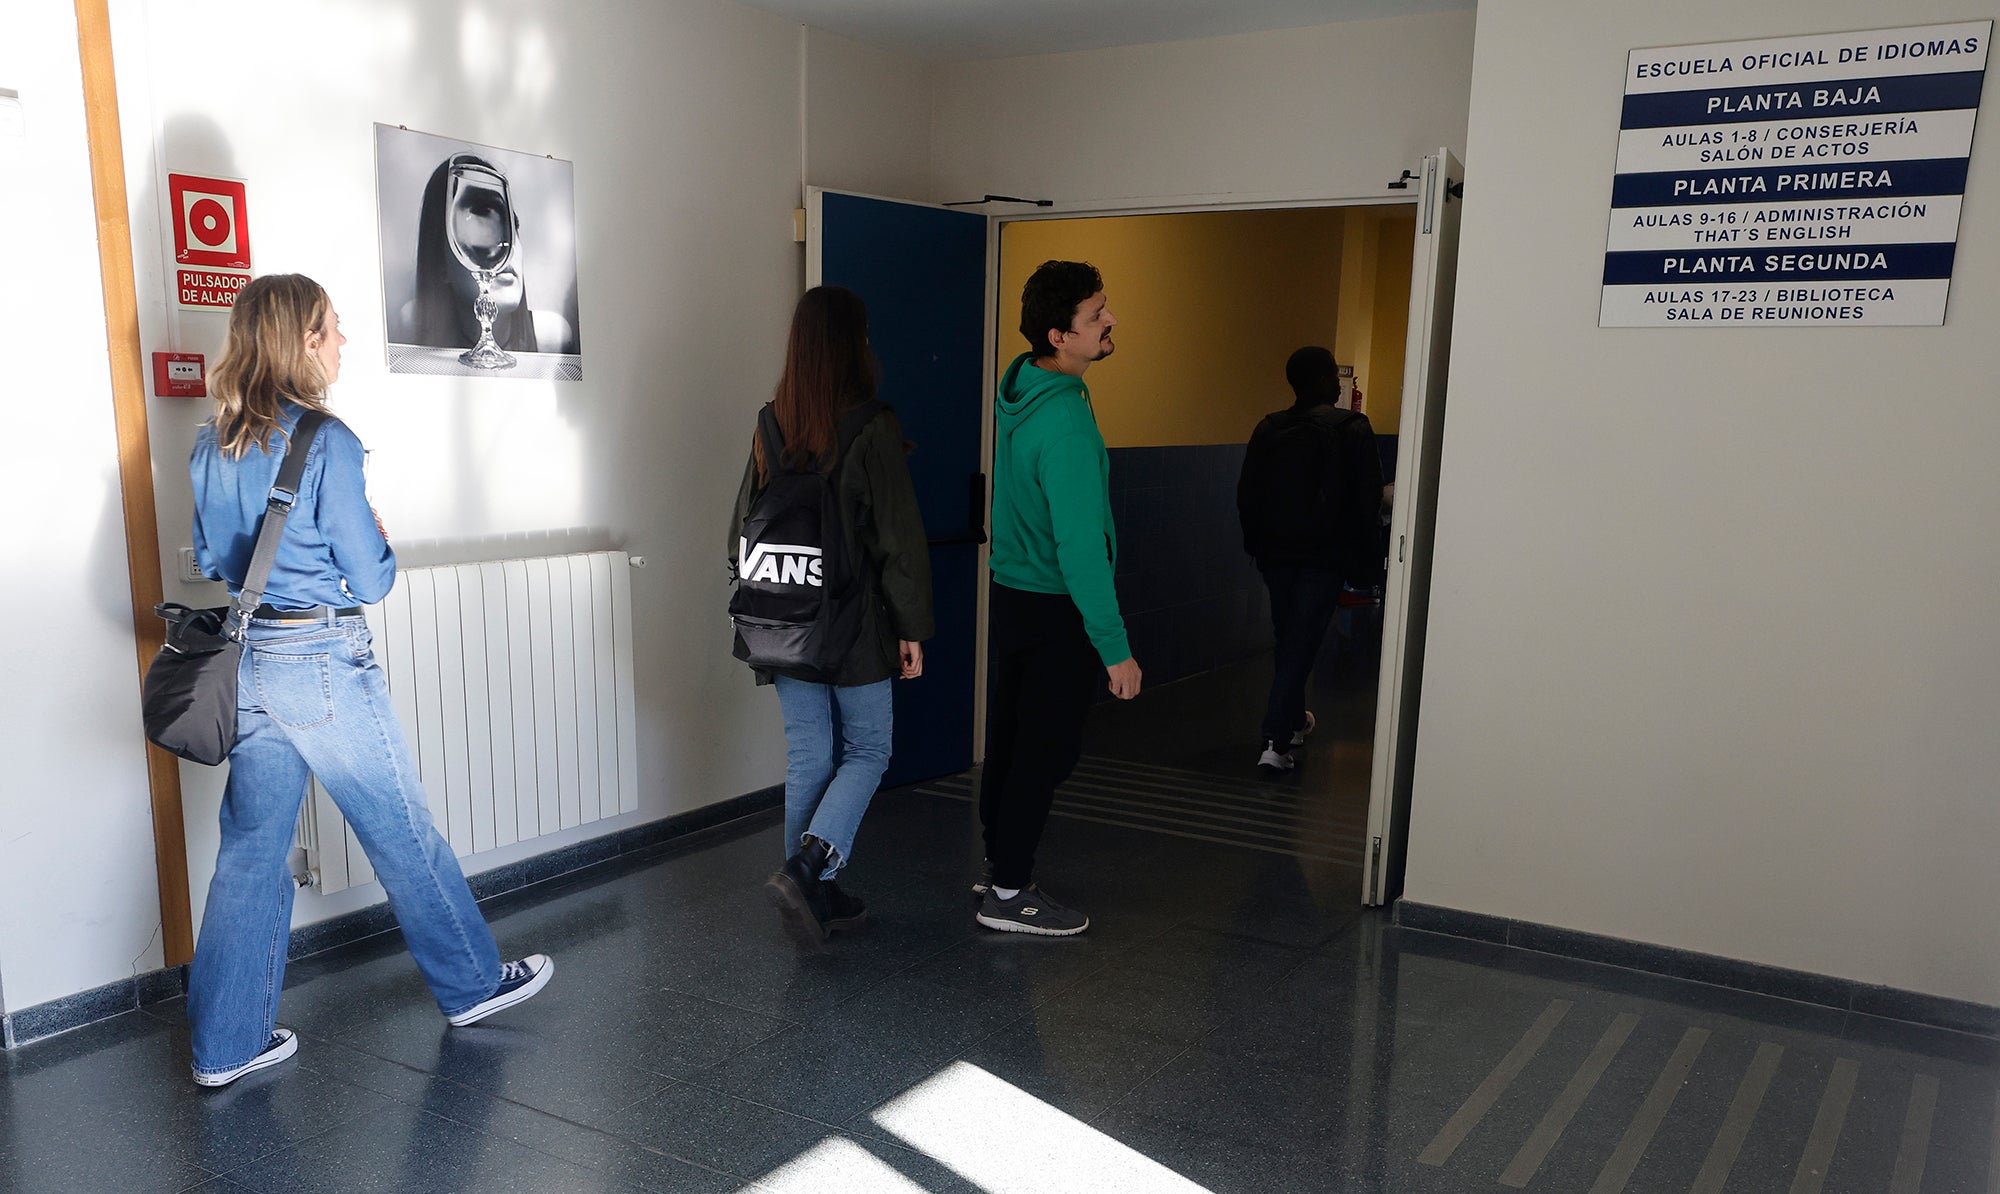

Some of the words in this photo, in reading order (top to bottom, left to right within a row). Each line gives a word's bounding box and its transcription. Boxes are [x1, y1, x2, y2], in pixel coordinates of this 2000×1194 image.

[1637, 58, 1733, 78] ESCUELA
[1742, 51, 1828, 70] OFICIAL
[1838, 47, 1868, 63] DE
[1877, 37, 1978, 60] IDIOMAS
[1707, 91, 1802, 114] PLANTA
[1813, 87, 1881, 106] BAJA
[1662, 131, 1723, 147] AULAS
[1732, 130, 1757, 143] 1-8
[1764, 129, 1769, 142] /
[1777, 117, 1918, 141] CONSERJERÍA
[1700, 145, 1763, 163] SALÓN
[1771, 146, 1795, 159] DE
[1802, 142, 1869, 157] ACTOS
[1674, 176, 1767, 196] PLANTA
[1777, 170, 1892, 191] PRIMERA
[1633, 213, 1692, 228] AULAS
[1700, 212, 1736, 225] 9-16
[1743, 212, 1748, 223] /
[1754, 201, 1926, 223] ADMINISTRACIÓN
[1767, 225, 1851, 240] ENGLISH
[1663, 256, 1755, 274] PLANTA
[1765, 252, 1888, 271] SEGUNDA
[183, 273, 247, 289] PULSADOR
[182, 289, 198, 302] DE
[1644, 290, 1703, 304] AULAS
[1711, 290, 1757, 302] 17-23
[1764, 290, 1770, 302] /
[1777, 288, 1895, 302] BIBLIOTECA
[1666, 308, 1713, 320] SALA
[1721, 307, 1744, 320] DE
[1752, 306, 1863, 320] REUNIONES
[739, 536, 822, 587] VANS
